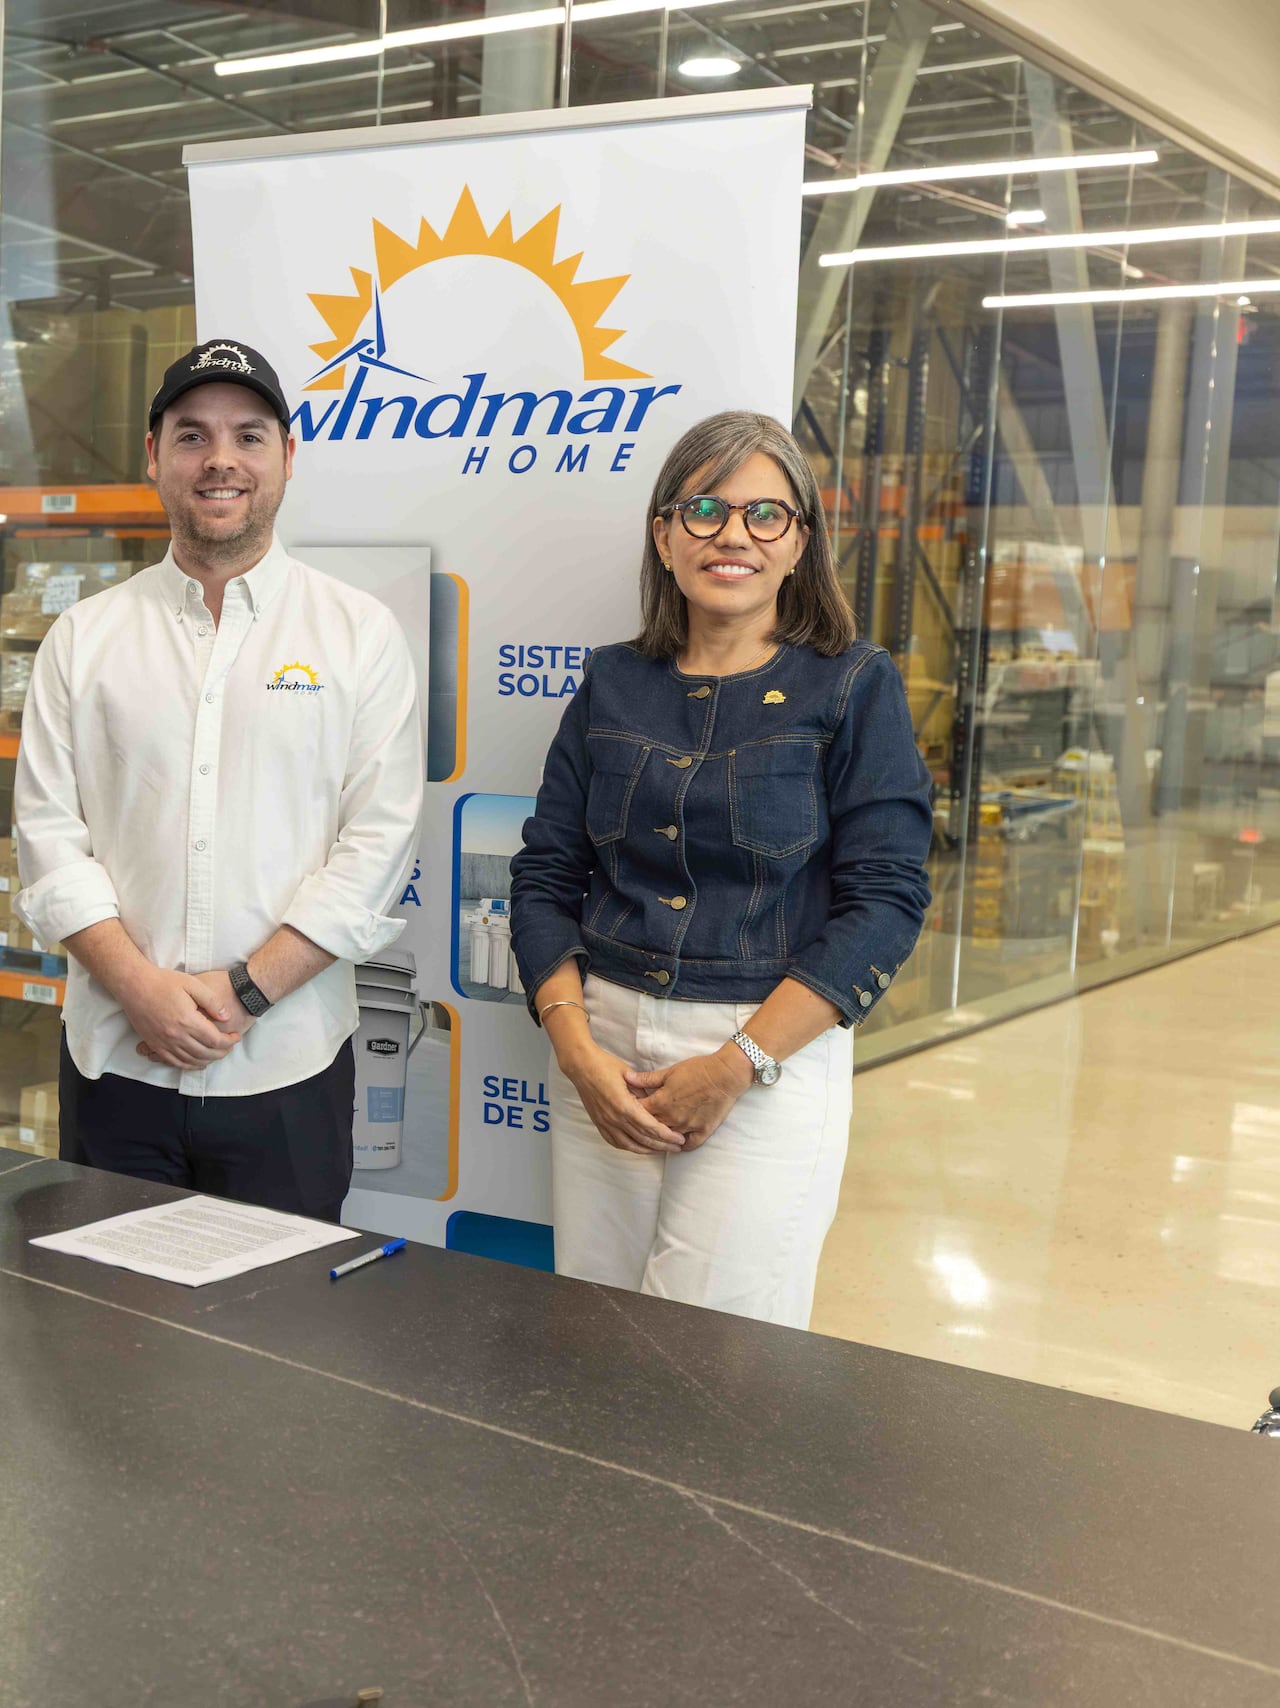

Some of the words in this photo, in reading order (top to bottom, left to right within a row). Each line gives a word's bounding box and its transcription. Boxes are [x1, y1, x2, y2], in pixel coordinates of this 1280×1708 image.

[461, 442, 636, 475] HOME
[498, 672, 578, 698] SOLA
[483, 1075, 550, 1106] SELL
[483, 1102, 524, 1129] DE
